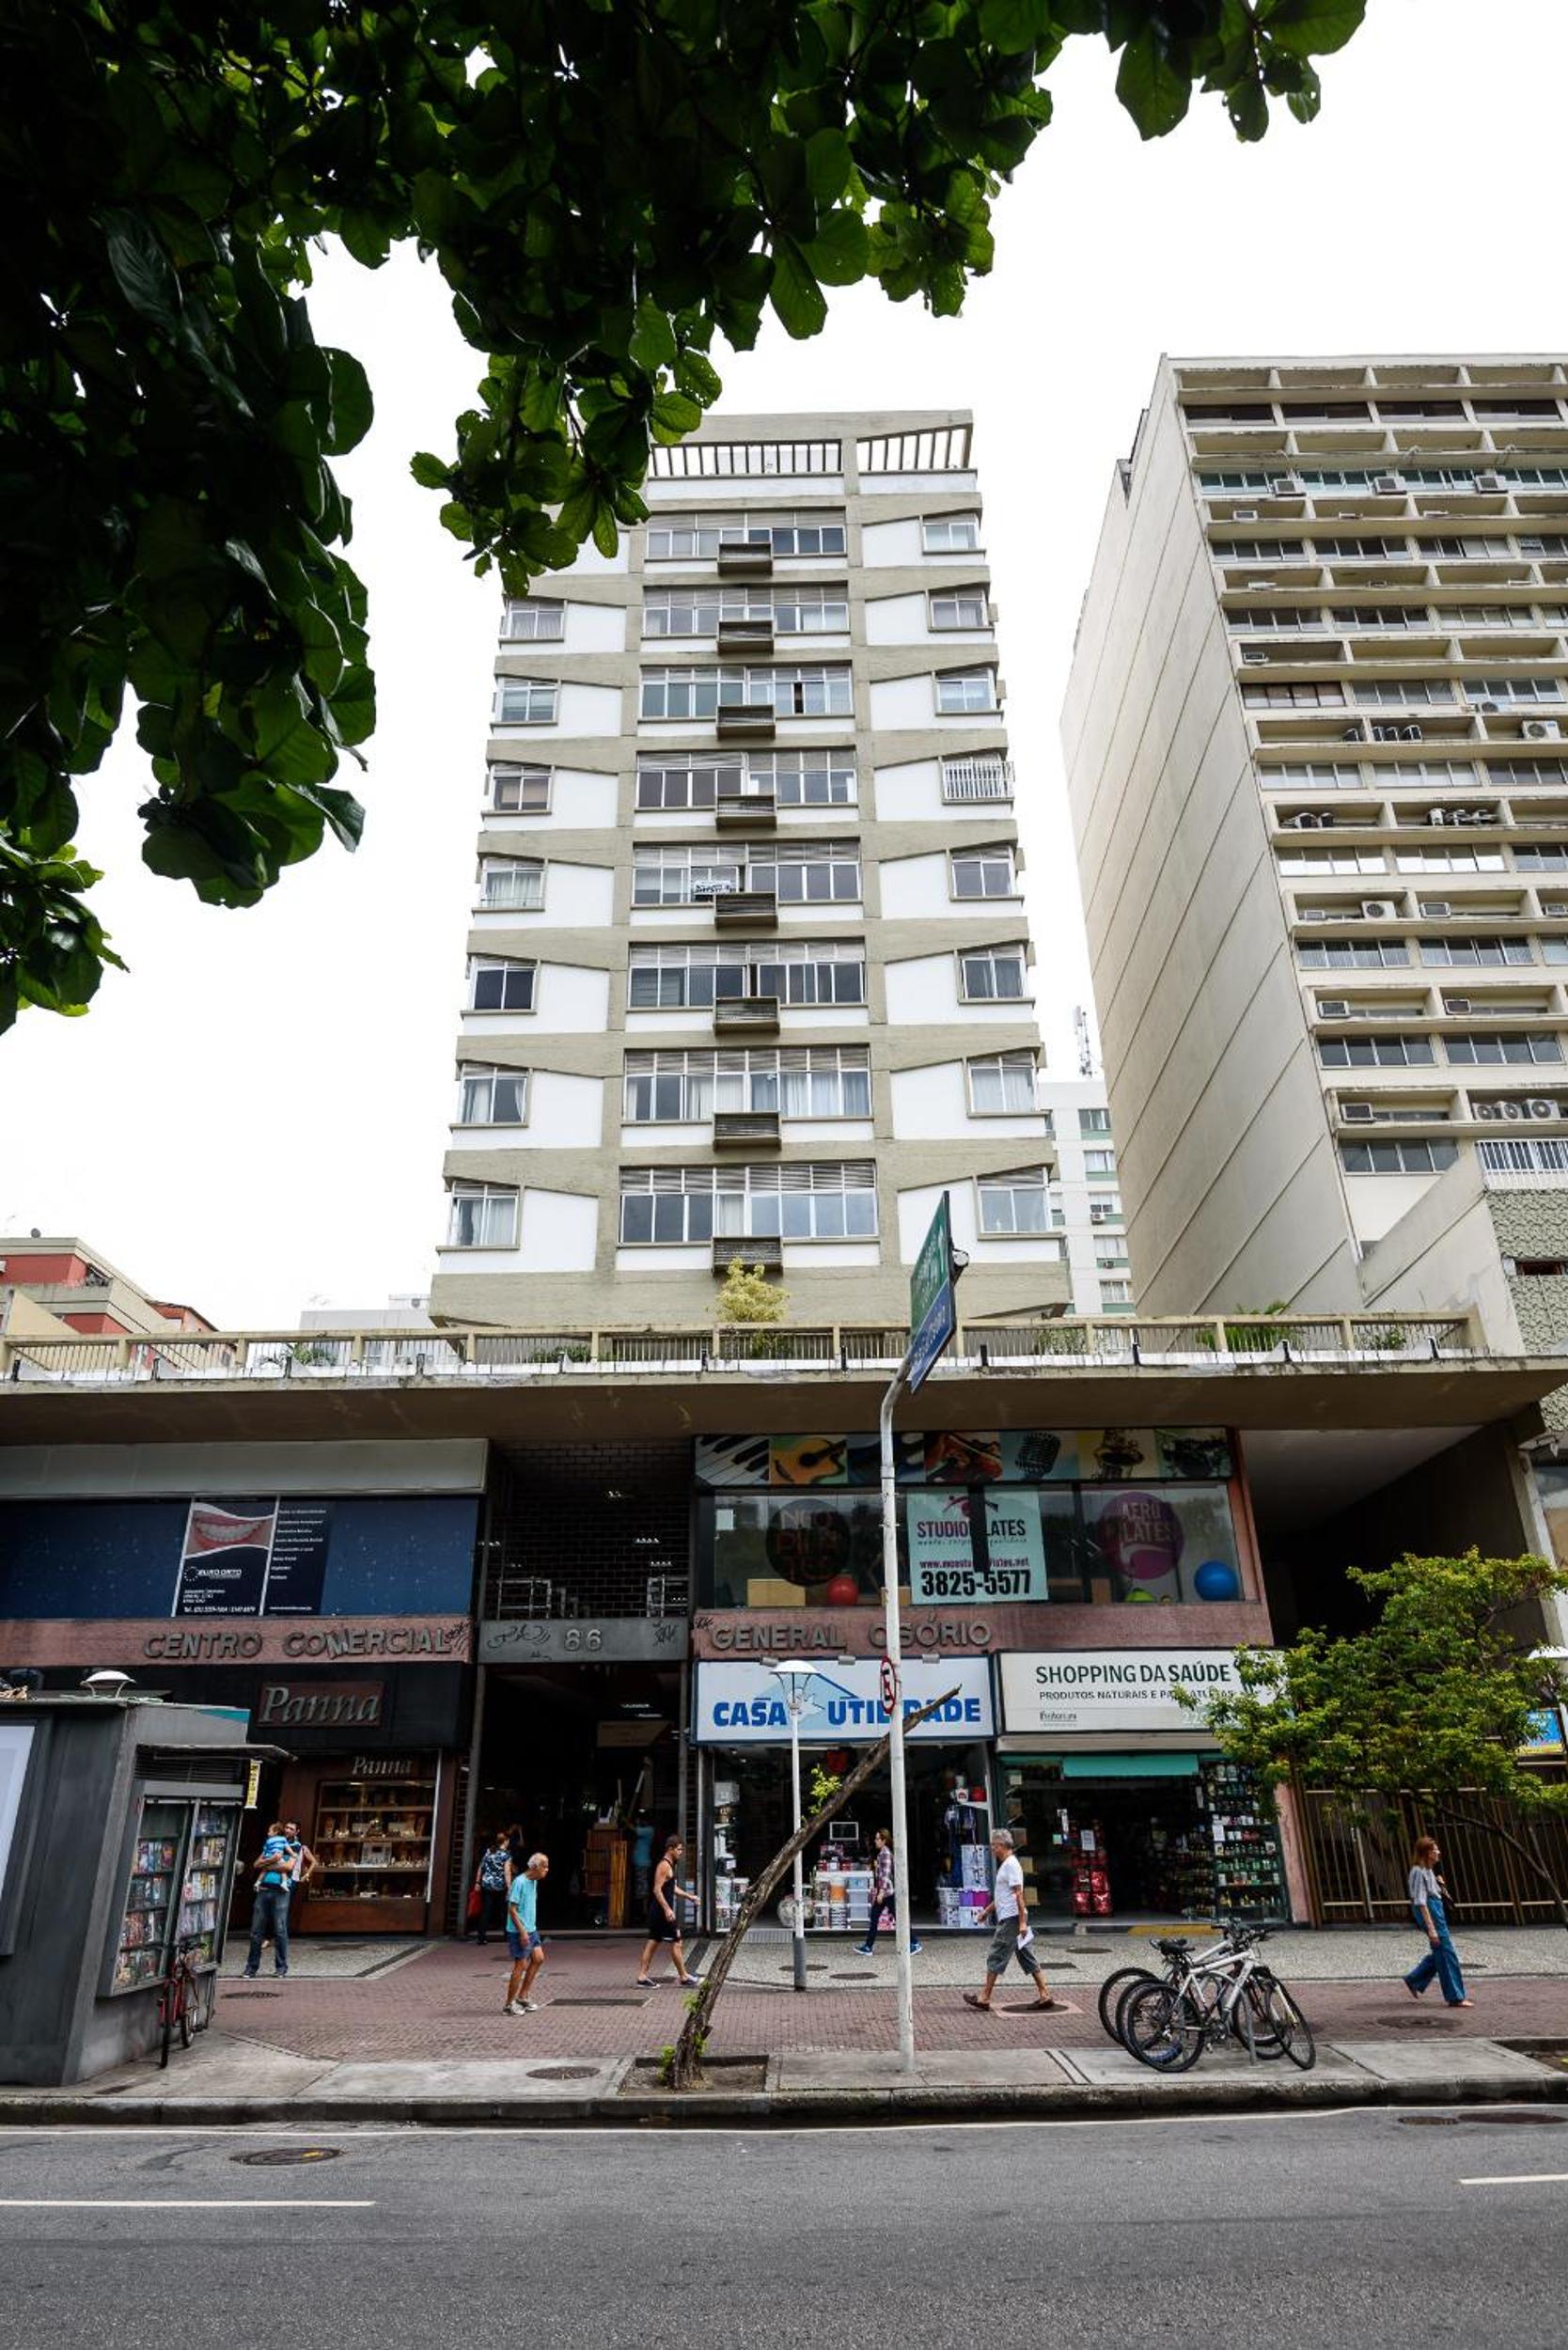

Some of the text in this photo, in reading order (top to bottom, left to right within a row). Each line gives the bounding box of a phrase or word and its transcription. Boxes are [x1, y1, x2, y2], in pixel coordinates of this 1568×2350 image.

[917, 1520, 969, 1538] STUDIO
[921, 1569, 1031, 1596] 3825-5577
[144, 1632, 263, 1658] CENTRO
[283, 1628, 452, 1660] COMERCIAL
[565, 1629, 602, 1652] 86
[712, 1623, 847, 1650] GENERAL
[869, 1614, 993, 1647] OSÓRIO
[1036, 1661, 1231, 1684] SHOPPING DA SAÚDE
[259, 1686, 380, 1724] Panna
[1040, 1691, 1095, 1700] PRODUTOS
[1097, 1690, 1148, 1700] NATURAIS
[1151, 1690, 1156, 1699] E
[713, 1699, 981, 1726] CASA UTILDADE
[352, 1756, 412, 1776] Panna
